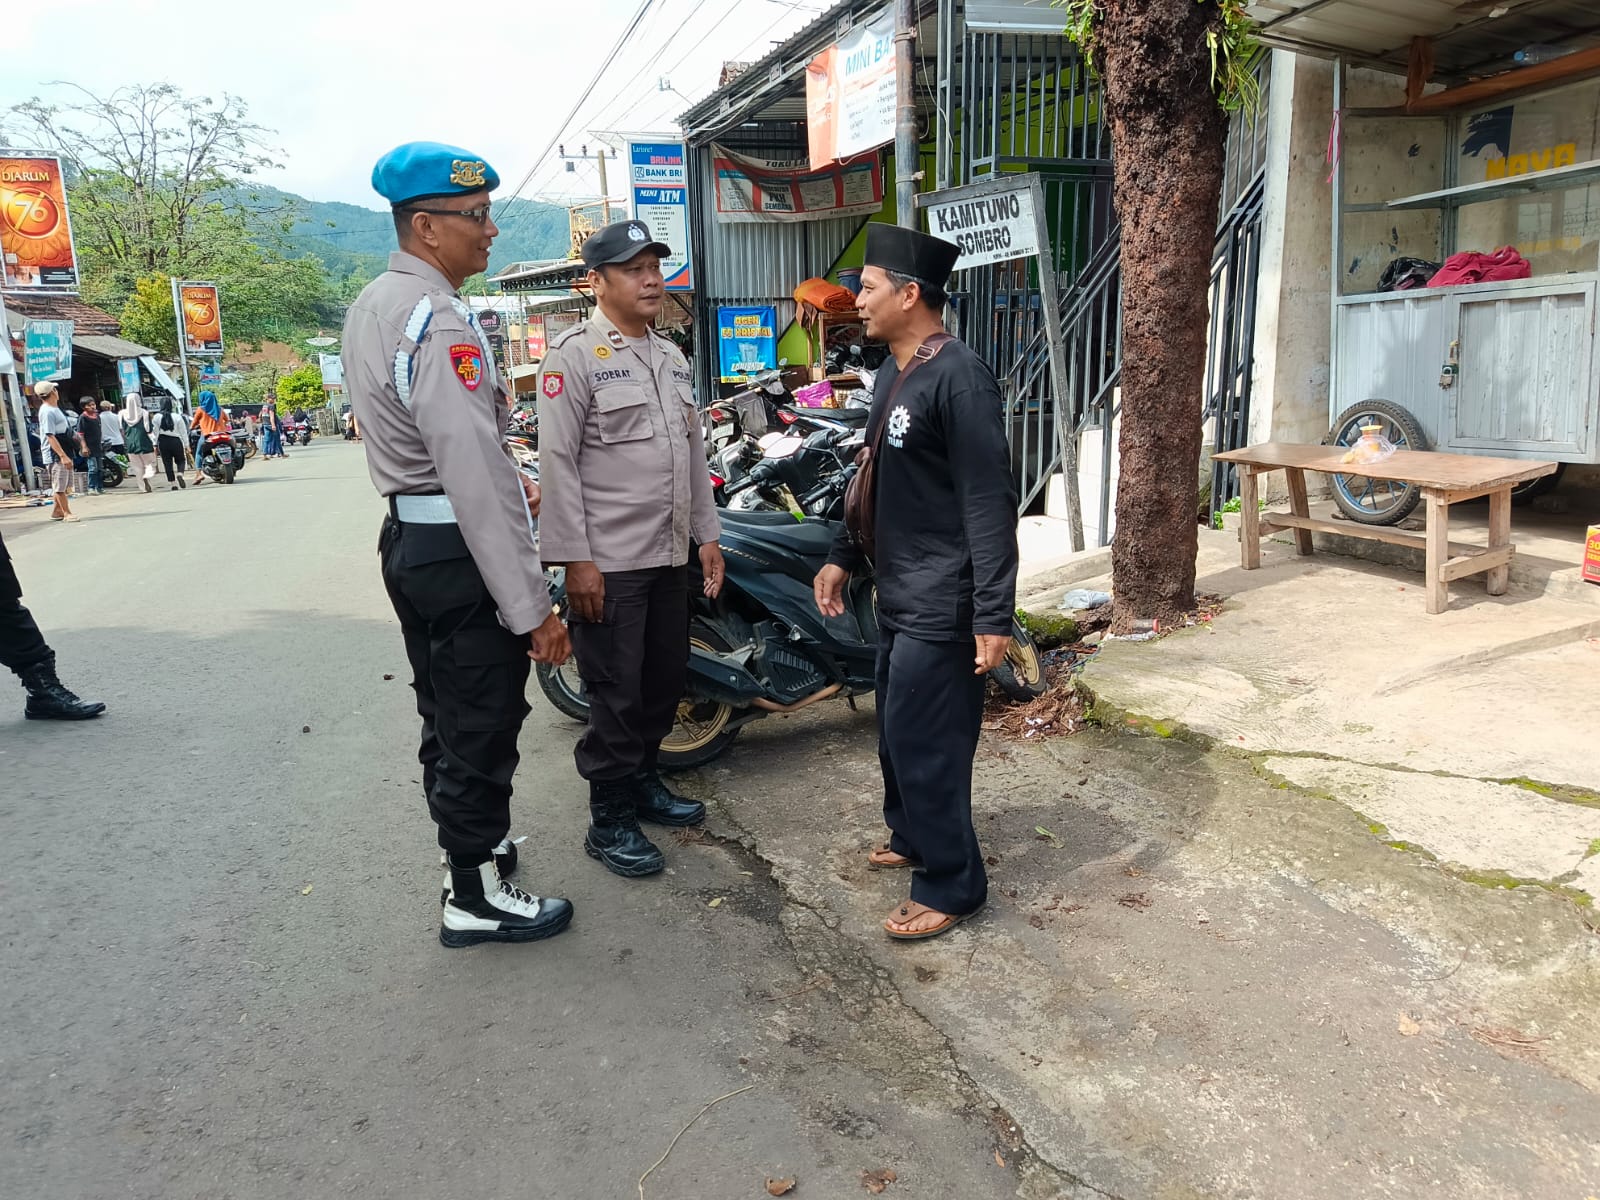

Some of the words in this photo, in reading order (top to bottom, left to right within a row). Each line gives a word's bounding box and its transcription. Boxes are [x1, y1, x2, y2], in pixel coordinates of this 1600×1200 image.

[845, 46, 871, 76] MINI
[650, 155, 682, 165] BRILINK
[765, 160, 792, 168] TOKO
[2, 171, 50, 182] DJARUM
[645, 168, 667, 177] BANK
[669, 169, 683, 177] BRI
[639, 189, 658, 197] MINI
[658, 190, 681, 203] ATM
[15, 192, 49, 231] 76
[936, 194, 1020, 233] KAMITUWO
[956, 225, 1011, 257] SOMBRO
[190, 303, 210, 323] 76
[734, 315, 760, 326] AGEN
[735, 326, 773, 338] KRISTAL
[594, 369, 631, 382] SOERAT
